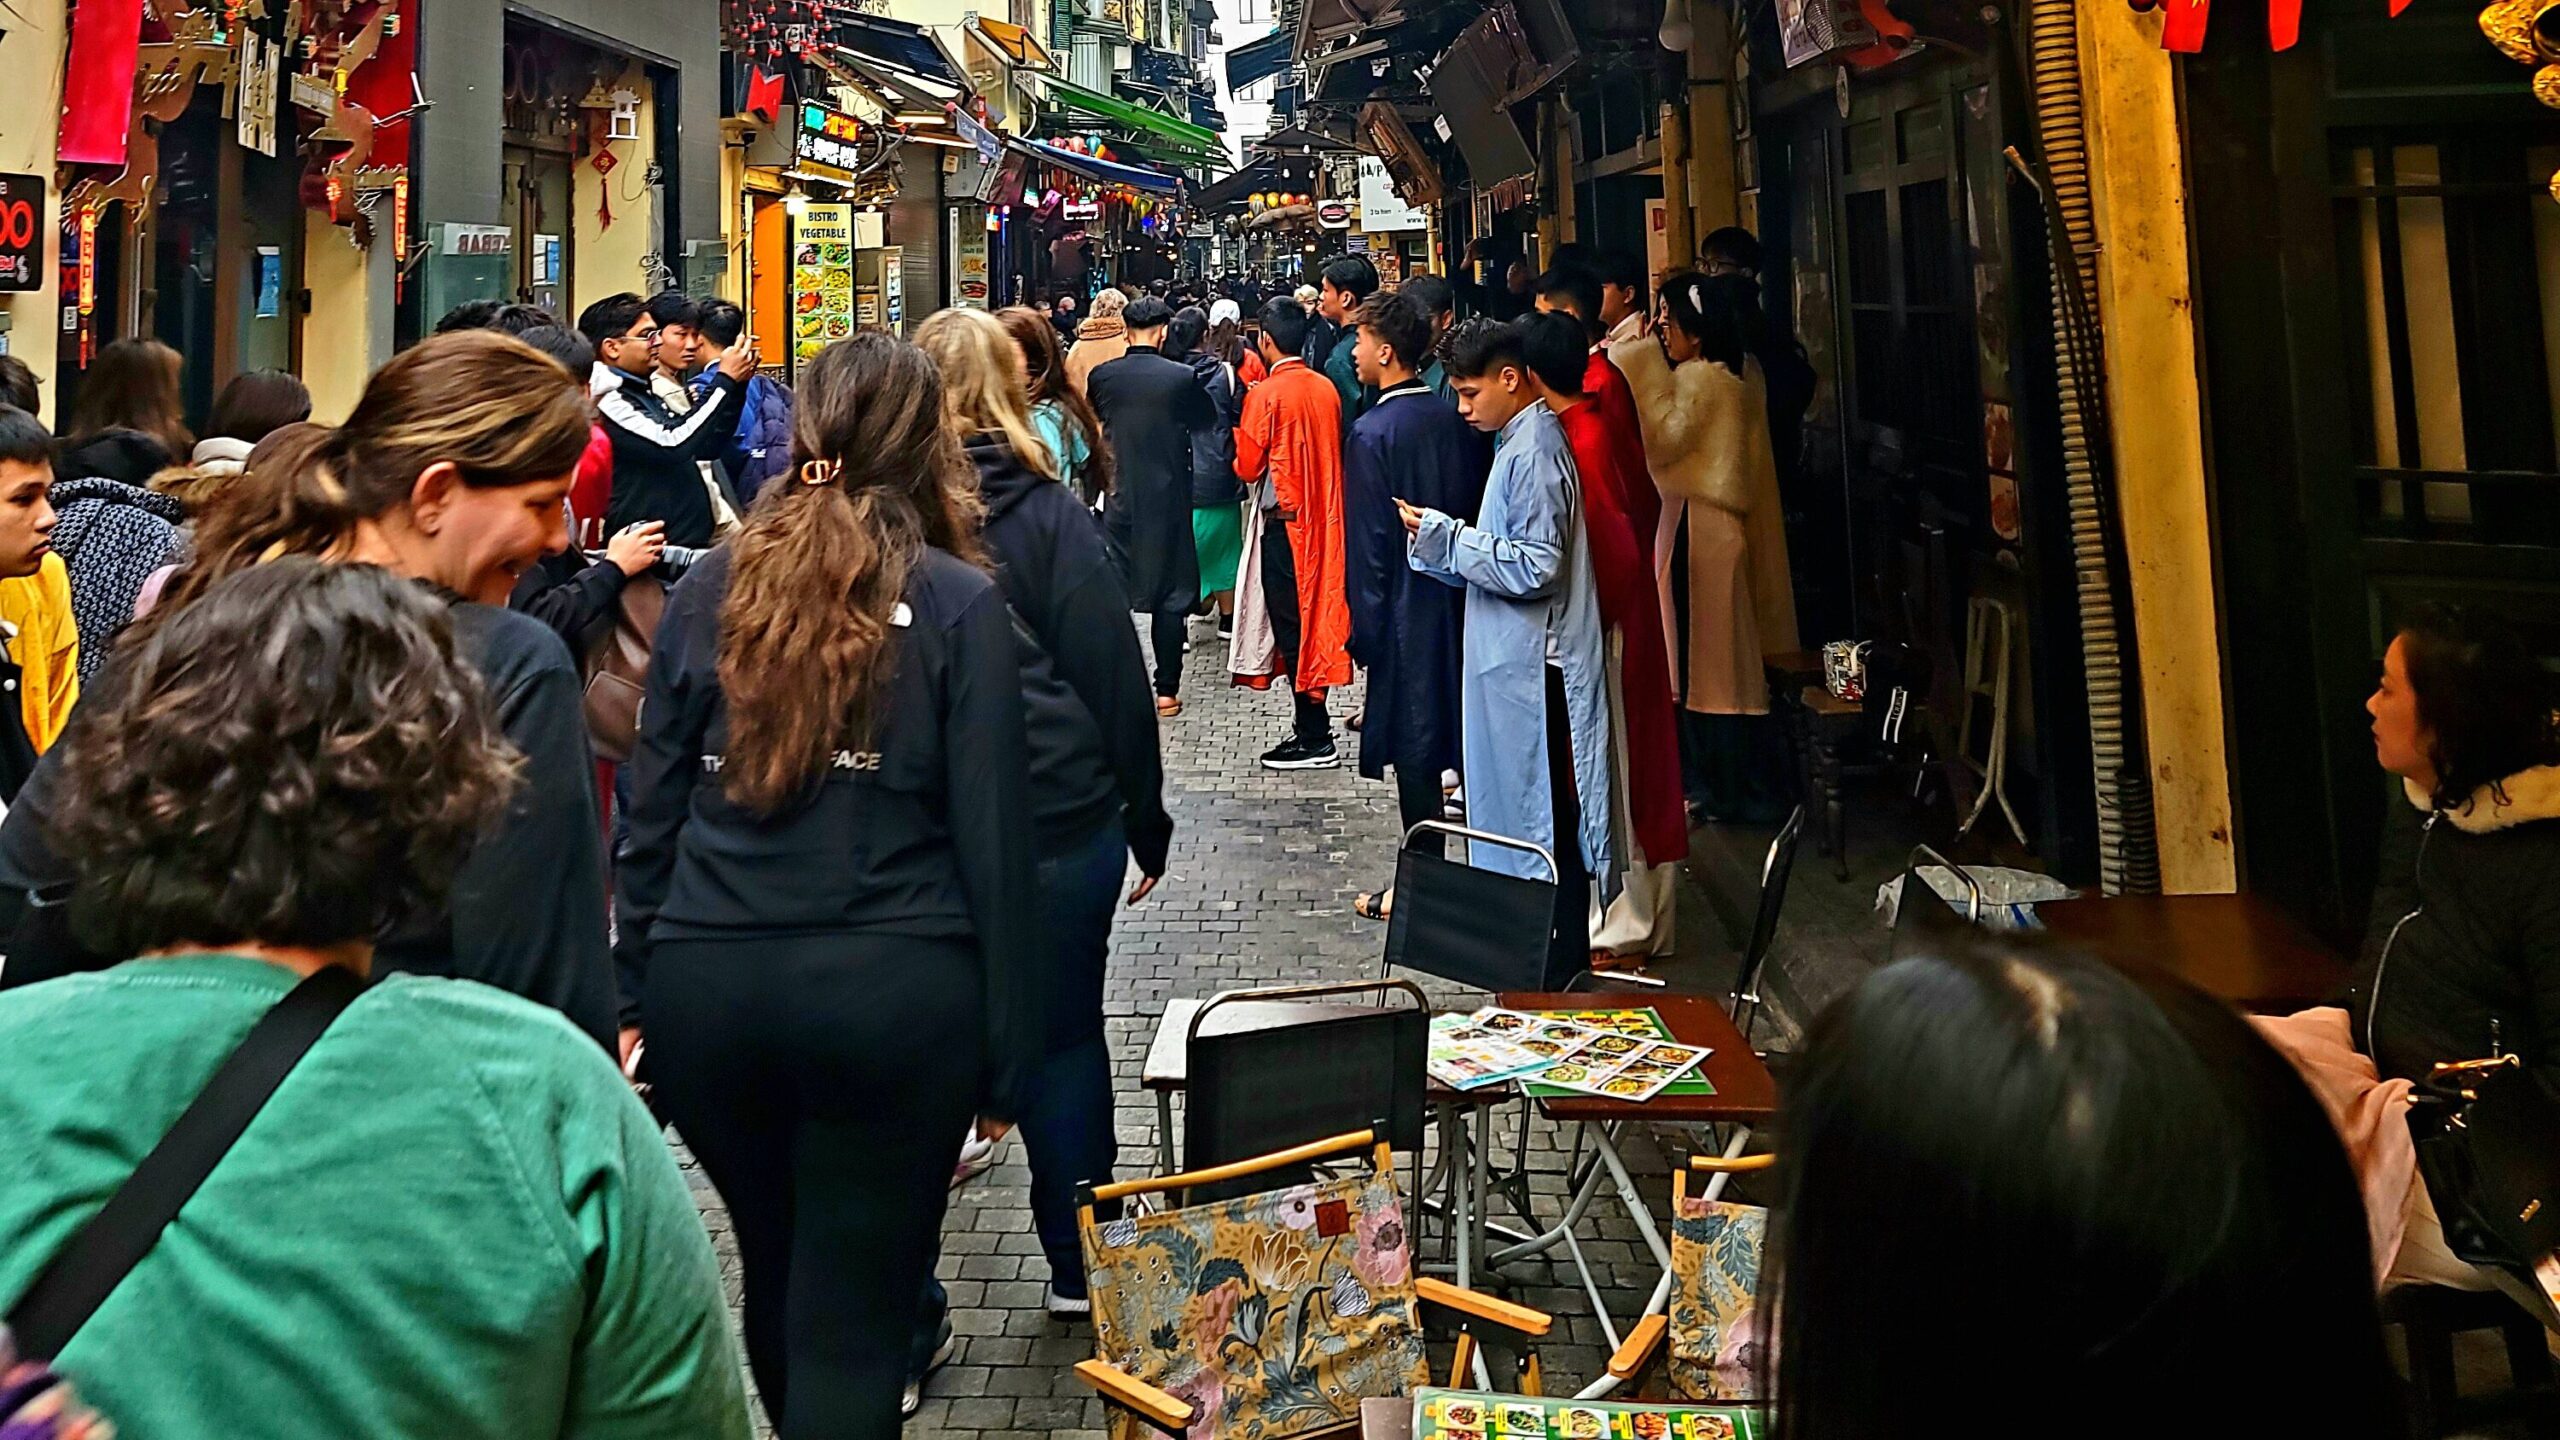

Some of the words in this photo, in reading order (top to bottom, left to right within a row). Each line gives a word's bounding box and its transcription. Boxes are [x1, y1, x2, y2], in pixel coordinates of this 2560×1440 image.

[808, 212, 838, 222] BISTRO
[800, 228, 846, 239] VEGETABLE
[701, 754, 726, 773] TH
